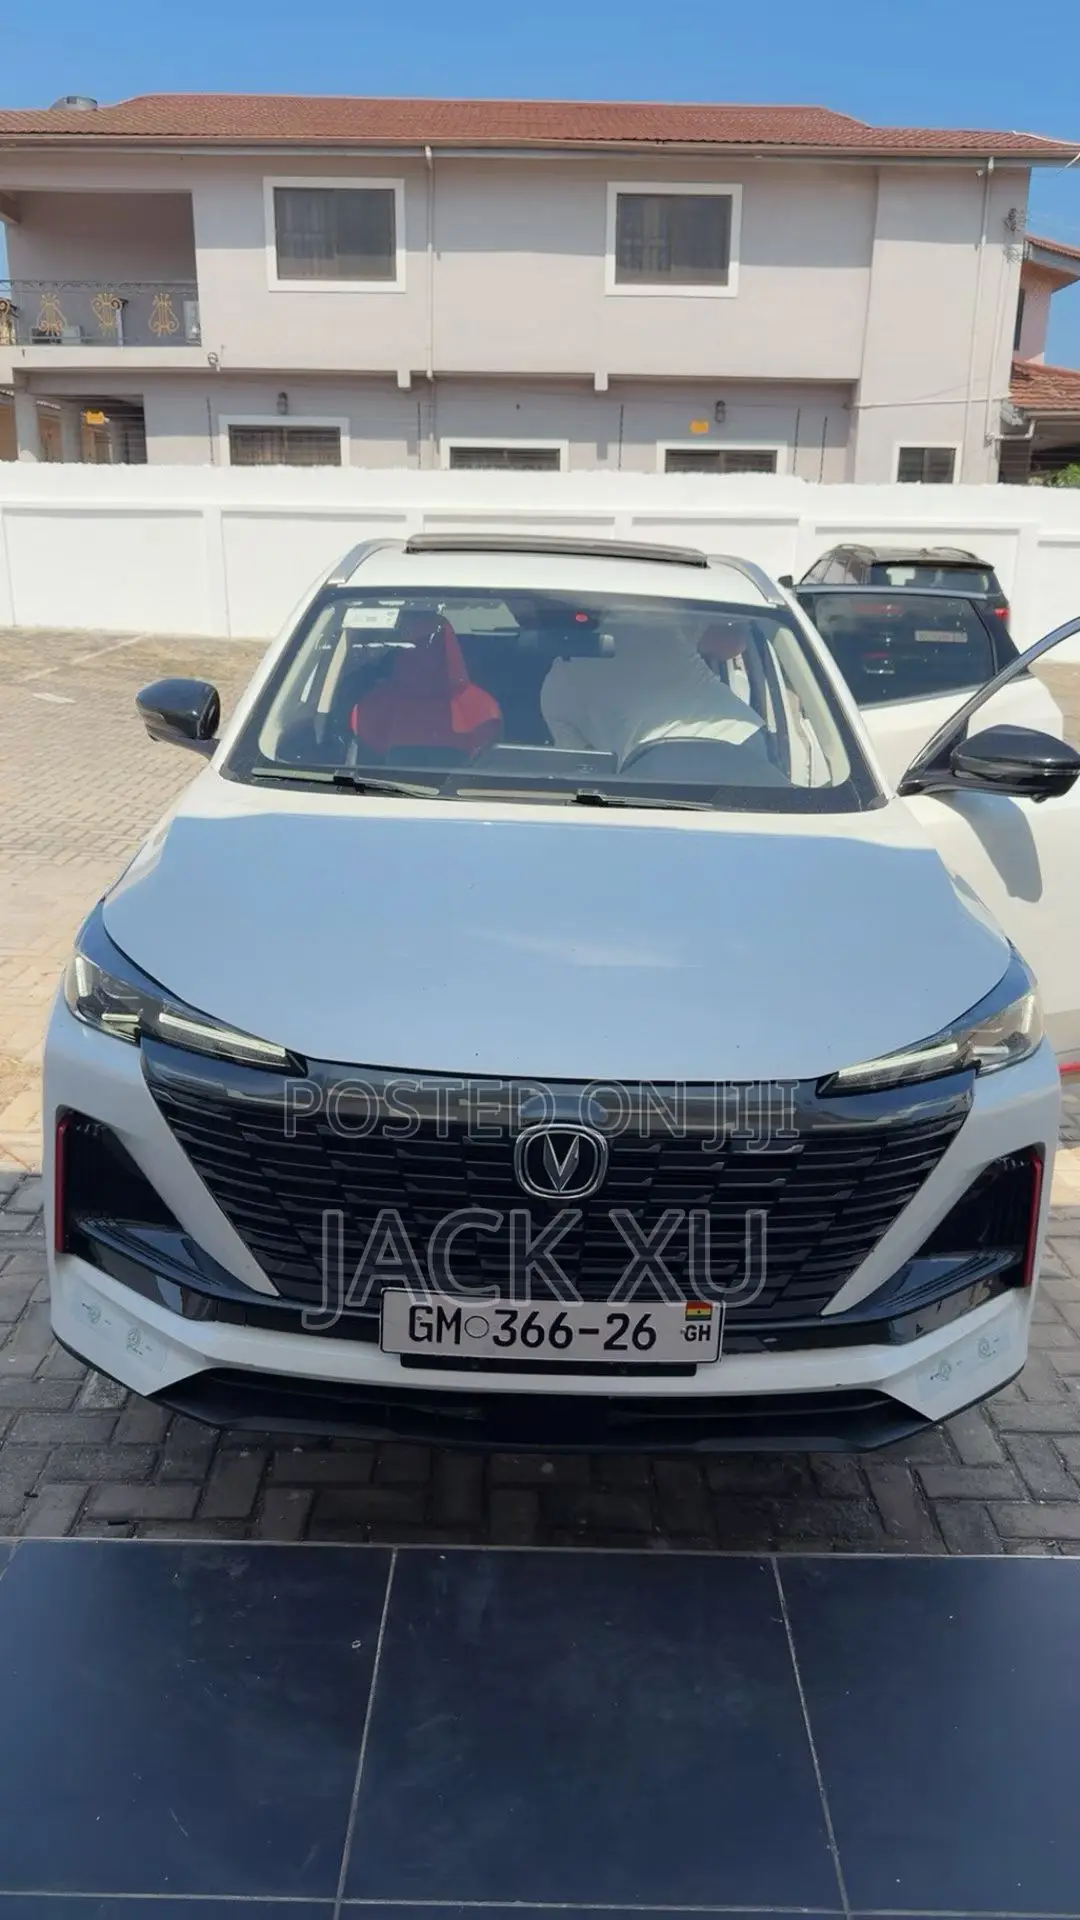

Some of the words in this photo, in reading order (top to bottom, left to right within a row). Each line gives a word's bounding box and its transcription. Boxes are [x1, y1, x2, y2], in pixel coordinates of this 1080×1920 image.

[408, 1304, 463, 1345] GM
[492, 1308, 657, 1351] 366-26
[684, 1324, 711, 1343] GH
